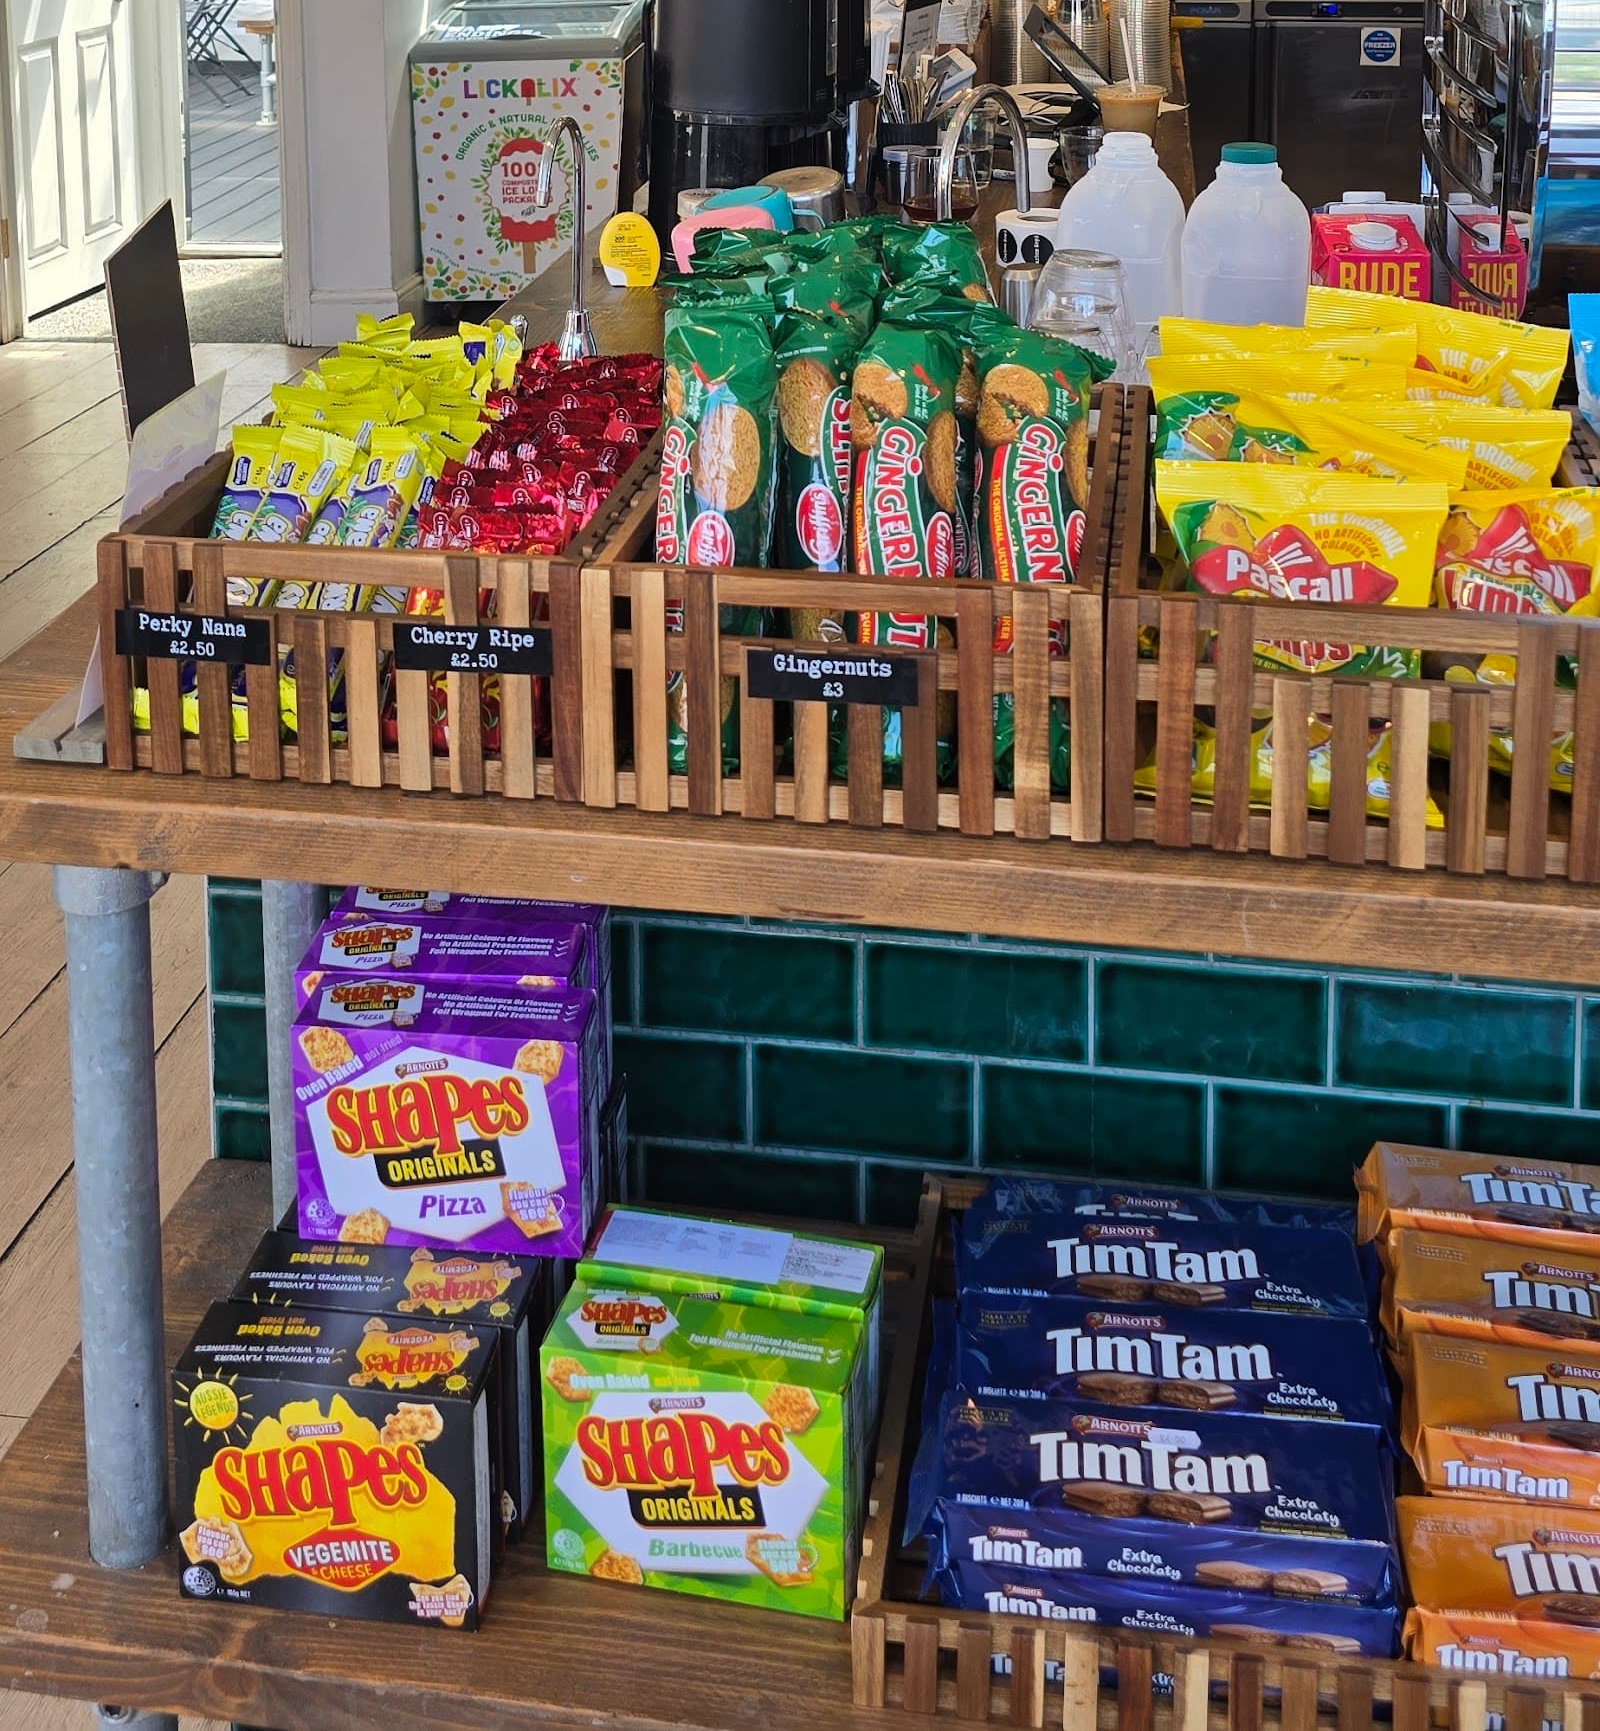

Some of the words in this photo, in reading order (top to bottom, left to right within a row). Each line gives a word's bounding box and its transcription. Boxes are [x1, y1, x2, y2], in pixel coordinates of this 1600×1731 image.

[456, 123, 488, 160] ORGANIC
[499, 115, 548, 124] NATURAL
[501, 162, 540, 177] 100
[502, 187, 518, 195] ICE
[1339, 262, 1420, 297] RUDE
[993, 477, 1001, 494] THE
[992, 495, 1004, 546] ORIGINAL
[856, 508, 866, 554] ORIGINAL
[1308, 513, 1339, 527] THE
[1343, 514, 1408, 558] ORIGINAL
[1314, 529, 1330, 541] NO
[1334, 528, 1382, 559] ARTIFICIAL
[1321, 540, 1365, 559] COLOURS
[1226, 549, 1354, 602] Pascall
[138, 614, 191, 638] Perky
[201, 617, 247, 638] Nana
[410, 627, 479, 650] Cherry
[489, 630, 534, 650] Ripe
[169, 641, 215, 657] £2.50
[450, 653, 498, 669] £2.50
[773, 653, 892, 679] Gingernuts
[822, 682, 844, 699] £3
[434, 933, 471, 941] Artificial
[472, 934, 505, 942] Colours
[518, 936, 554, 944] Flavours
[348, 945, 393, 955] ORIGINALS
[448, 949, 484, 957] Wrapped
[355, 956, 383, 964] Pizza
[348, 1001, 395, 1010] ORIGINALS
[479, 995, 513, 1004] Colours
[526, 998, 563, 1008] Flavours
[355, 1013, 384, 1021] Pizza
[452, 1009, 491, 1018] Wrapped
[510, 1012, 558, 1020] Freshness
[296, 1075, 329, 1101] Oven
[327, 1056, 364, 1085] Baked
[364, 1049, 379, 1063] not
[380, 1034, 404, 1055] fried
[388, 1150, 497, 1183] ORIGINALS
[1509, 1167, 1563, 1178] ARNOTT'S
[1460, 1173, 1600, 1214] TimTa
[419, 1194, 486, 1219] Pizza
[1127, 1196, 1179, 1210] ARNOTT'S
[1100, 1225, 1155, 1239] ARNOTT'S
[290, 1252, 334, 1264] Baked
[340, 1254, 370, 1266] Oven
[249, 1271, 301, 1280] FRESHNESS
[434, 1264, 479, 1274] VEGEMITE
[1538, 1265, 1595, 1281] ARNOTT'S
[268, 1280, 314, 1289] FLAVOURS
[320, 1273, 361, 1282] WRAPPED
[364, 1275, 384, 1283] FOIL
[317, 1282, 363, 1291] ARTIFICIAL
[1265, 1281, 1303, 1295] Extra
[1254, 1287, 1322, 1308] Chocolaty
[237, 1323, 285, 1335] Baked
[1102, 1313, 1162, 1329] ARNOTT'S
[289, 1325, 321, 1337] Oven
[600, 1325, 648, 1334] ORIGINALS
[194, 1344, 247, 1352] FRESHNESS
[389, 1335, 435, 1345] VEGEMITE
[690, 1334, 705, 1344] Foil
[705, 1336, 752, 1352] Wrapped
[770, 1346, 822, 1362] Freshness
[741, 1332, 782, 1346] Artificial
[784, 1338, 824, 1354] Flavours
[213, 1353, 260, 1362] FLAVOURS
[267, 1345, 312, 1354] WRAPPED
[314, 1345, 335, 1354] FOIL
[262, 1354, 310, 1363] ARTIFICIAL
[194, 1388, 229, 1406] AUSSIE
[1279, 1382, 1318, 1399] Extra
[662, 1397, 703, 1408] ARNOTT'S
[1266, 1393, 1338, 1413] Chocolaty
[195, 1402, 236, 1420] LEGENDS
[297, 1423, 341, 1437] ARNOTT'S
[1090, 1420, 1151, 1434] ARNOTT'S
[641, 1497, 756, 1522] ORIGINALS
[1277, 1495, 1319, 1512] Extra
[1264, 1503, 1340, 1527] Chocolaty
[288, 1539, 394, 1568] VEGEMITE
[648, 1539, 743, 1559] Barbecue
[1122, 1547, 1162, 1565] Extra
[320, 1563, 374, 1580] CHEESE
[1107, 1559, 1181, 1580] Chocolaty
[1136, 1609, 1175, 1623] Extra
[1122, 1615, 1195, 1636] Chocolaty
